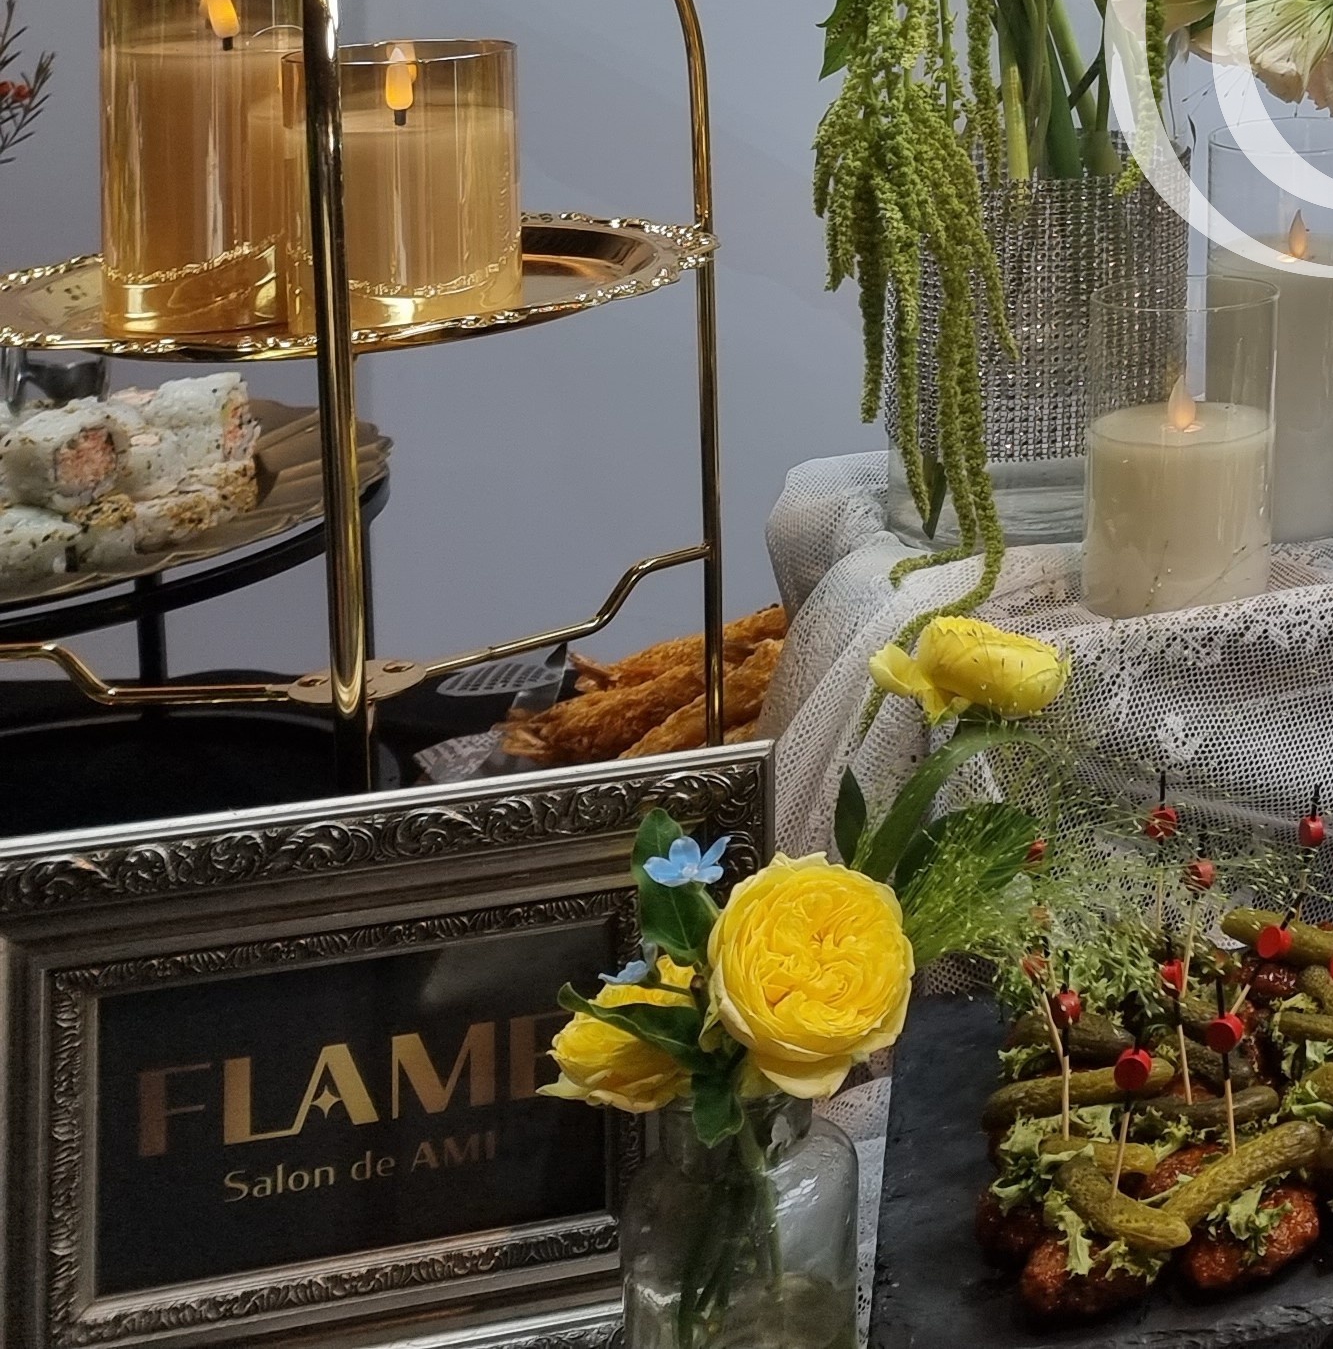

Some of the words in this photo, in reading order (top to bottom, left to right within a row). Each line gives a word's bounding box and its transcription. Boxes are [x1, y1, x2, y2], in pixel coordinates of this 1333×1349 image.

[136, 1010, 568, 1158] FLAME
[222, 1161, 336, 1203] Salon
[350, 1151, 396, 1183] de
[410, 1130, 497, 1171] AMI
